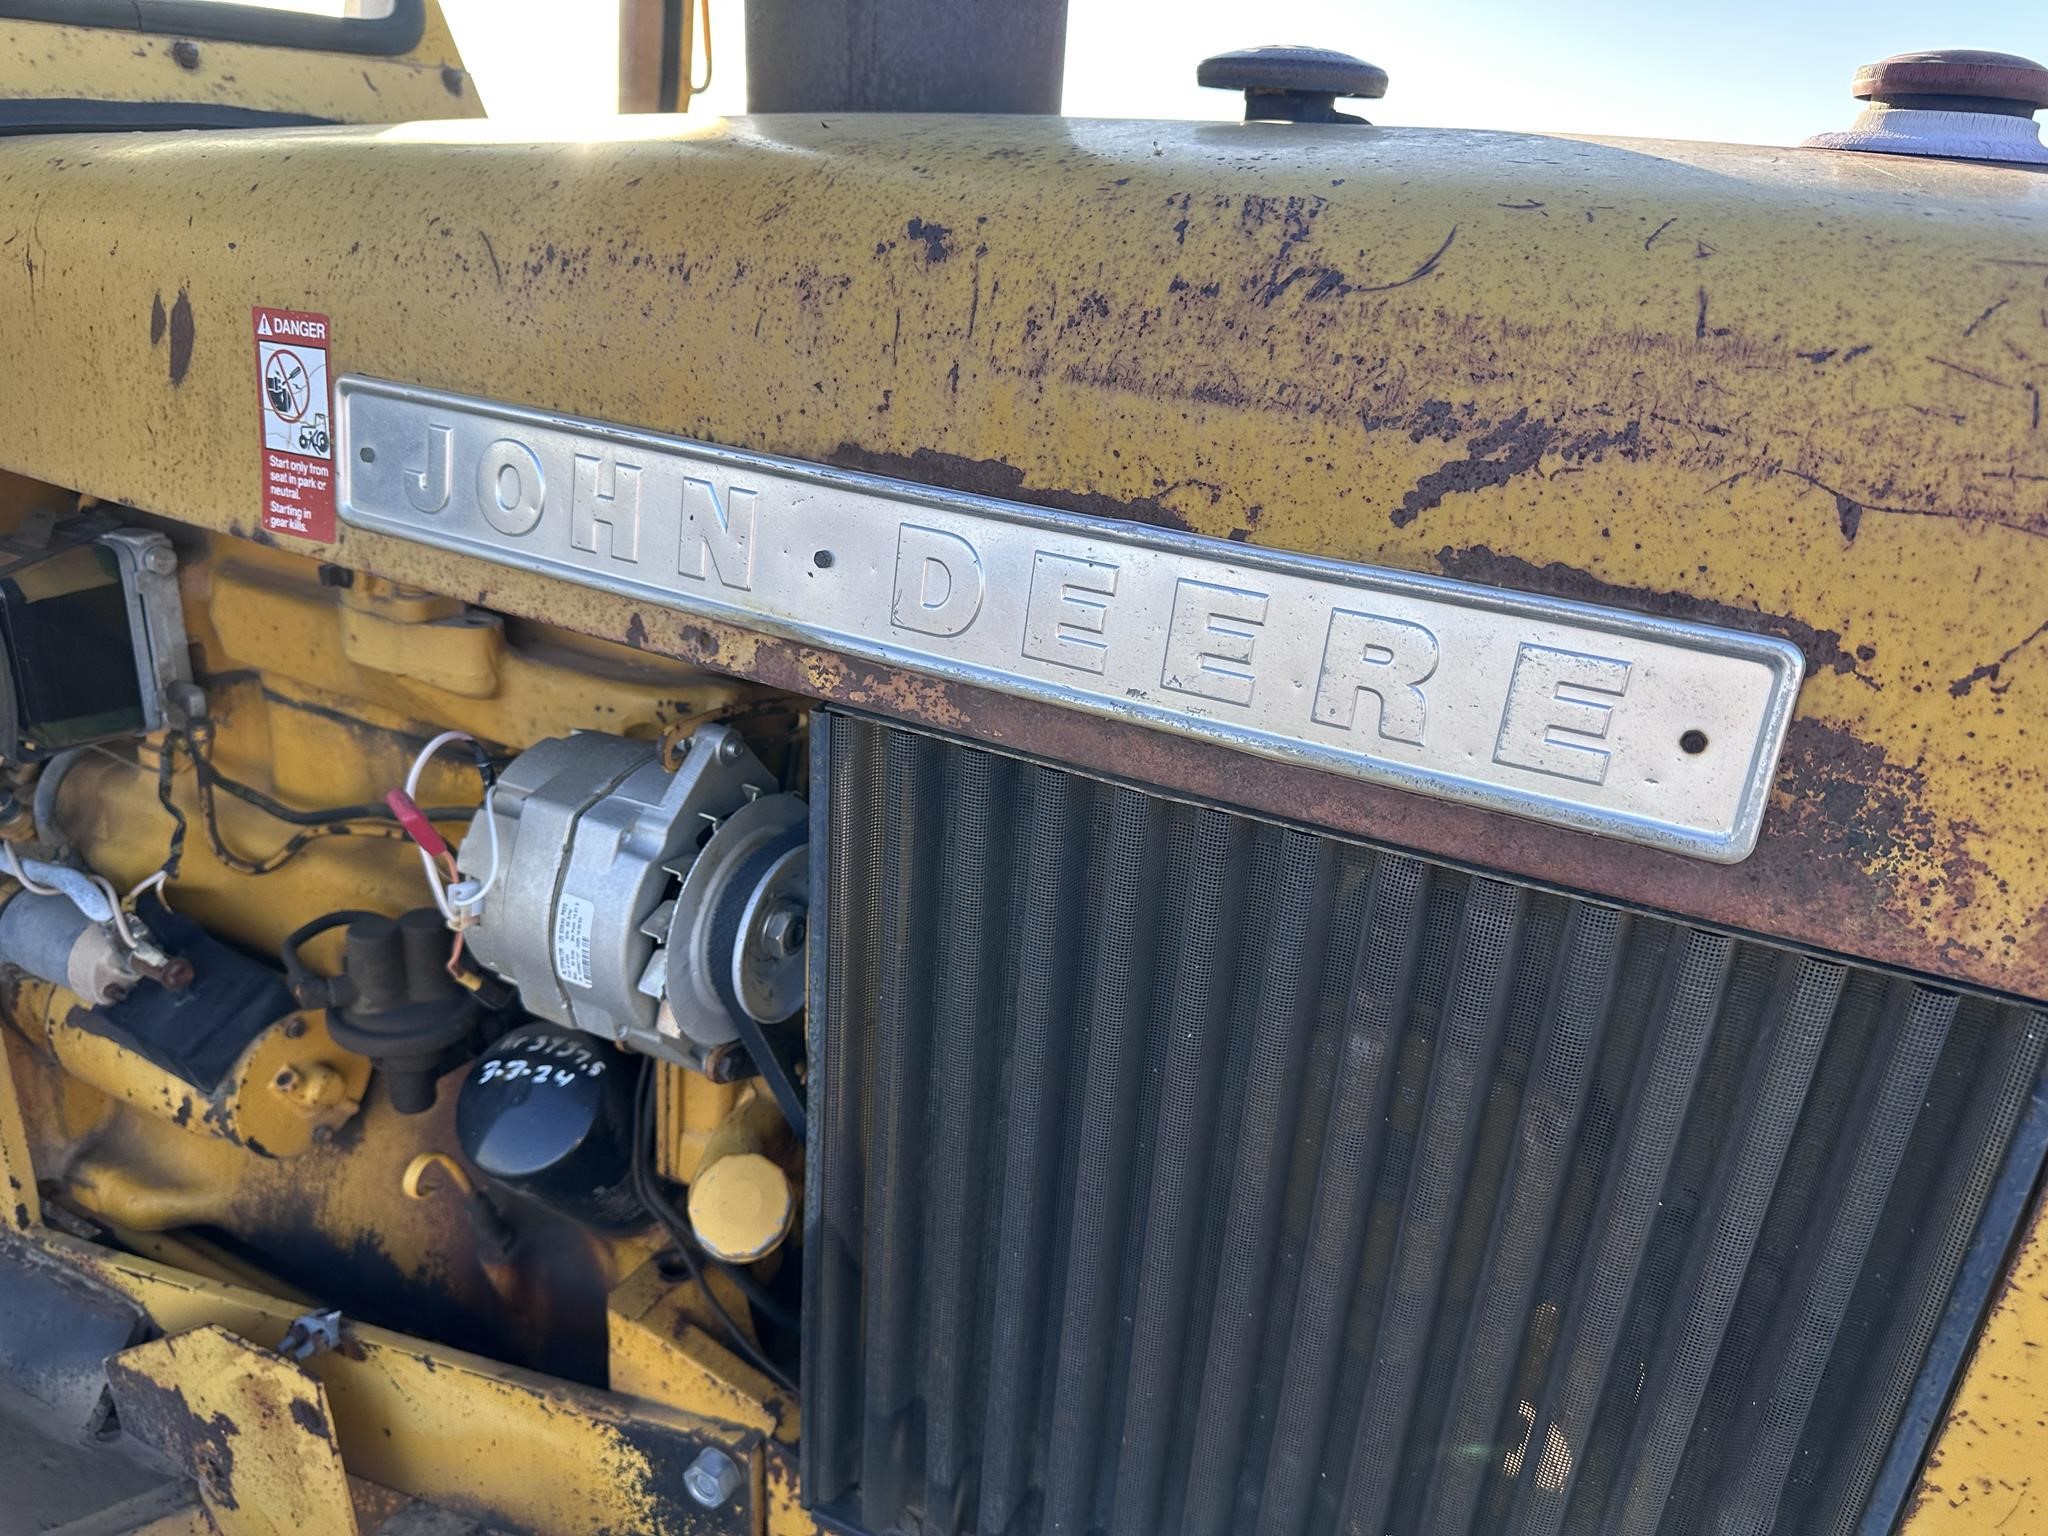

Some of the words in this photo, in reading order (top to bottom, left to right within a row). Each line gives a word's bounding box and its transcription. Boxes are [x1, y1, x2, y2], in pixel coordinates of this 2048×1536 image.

[273, 317, 326, 339] DANGER
[269, 455, 290, 470] Start
[290, 461, 309, 476] only
[309, 463, 329, 476] from
[270, 471, 288, 483] seat
[288, 473, 297, 485] in
[297, 477, 317, 488] park
[270, 485, 301, 500] neutral.
[270, 500, 302, 520] Starting
[303, 507, 312, 519] in
[270, 516, 288, 528] gear
[289, 519, 308, 532] kills.
[402, 423, 758, 592] JOHN
[890, 522, 1633, 786] DEERE
